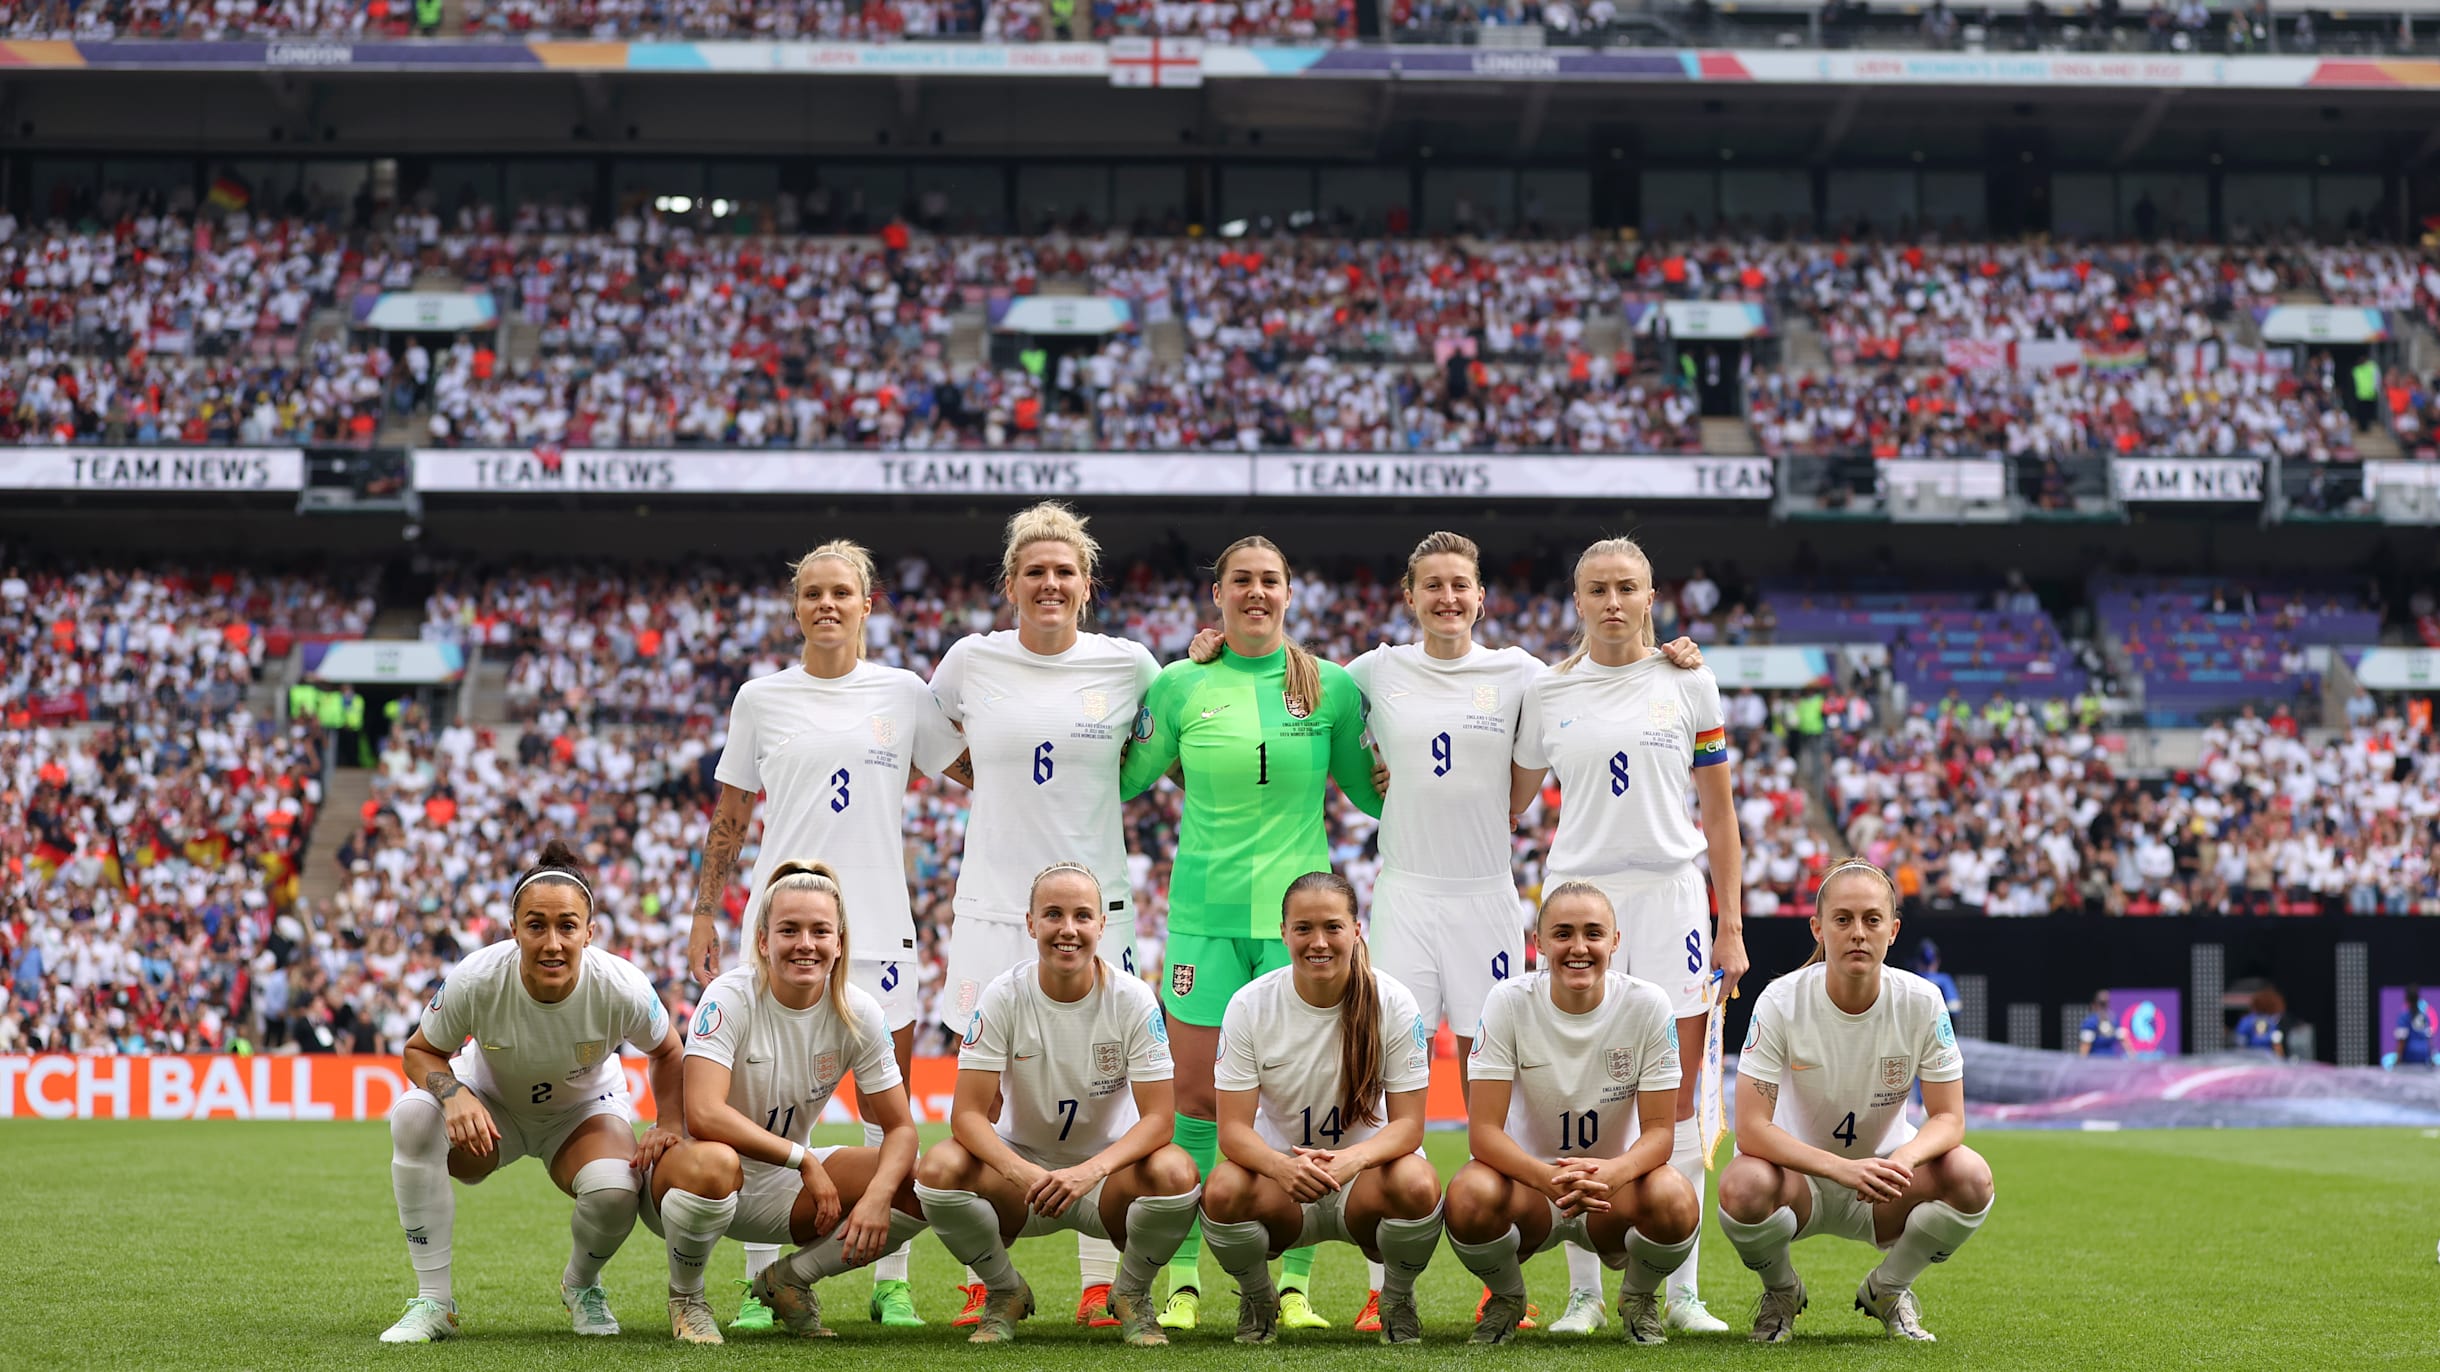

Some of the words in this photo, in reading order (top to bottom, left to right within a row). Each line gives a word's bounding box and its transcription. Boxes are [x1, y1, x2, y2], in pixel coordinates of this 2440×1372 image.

[266, 44, 352, 65] LONDON
[1472, 53, 1558, 75] LONDON
[72, 457, 161, 485] TEAM
[173, 457, 270, 485] NEWS
[475, 459, 564, 485] TEAM
[578, 459, 674, 485] NEWS
[881, 461, 971, 487] TEAM
[983, 461, 1081, 488] NEWS
[1291, 463, 1380, 490] TEAM
[1393, 463, 1490, 490] NEWS
[1033, 741, 1054, 785] 6
[1255, 741, 1269, 785] 1
[1431, 731, 1452, 778] 9
[1609, 750, 1629, 797] 8
[830, 767, 850, 813] 3
[1685, 928, 1703, 974] 8
[880, 961, 899, 992] 3
[148, 1057, 336, 1120] BALL
[531, 1082, 552, 1104] 2
[764, 1105, 796, 1138] 11
[1058, 1099, 1079, 1142] 7
[1300, 1105, 1344, 1146] 14
[1559, 1109, 1599, 1152] 10
[1832, 1111, 1858, 1148] 4
